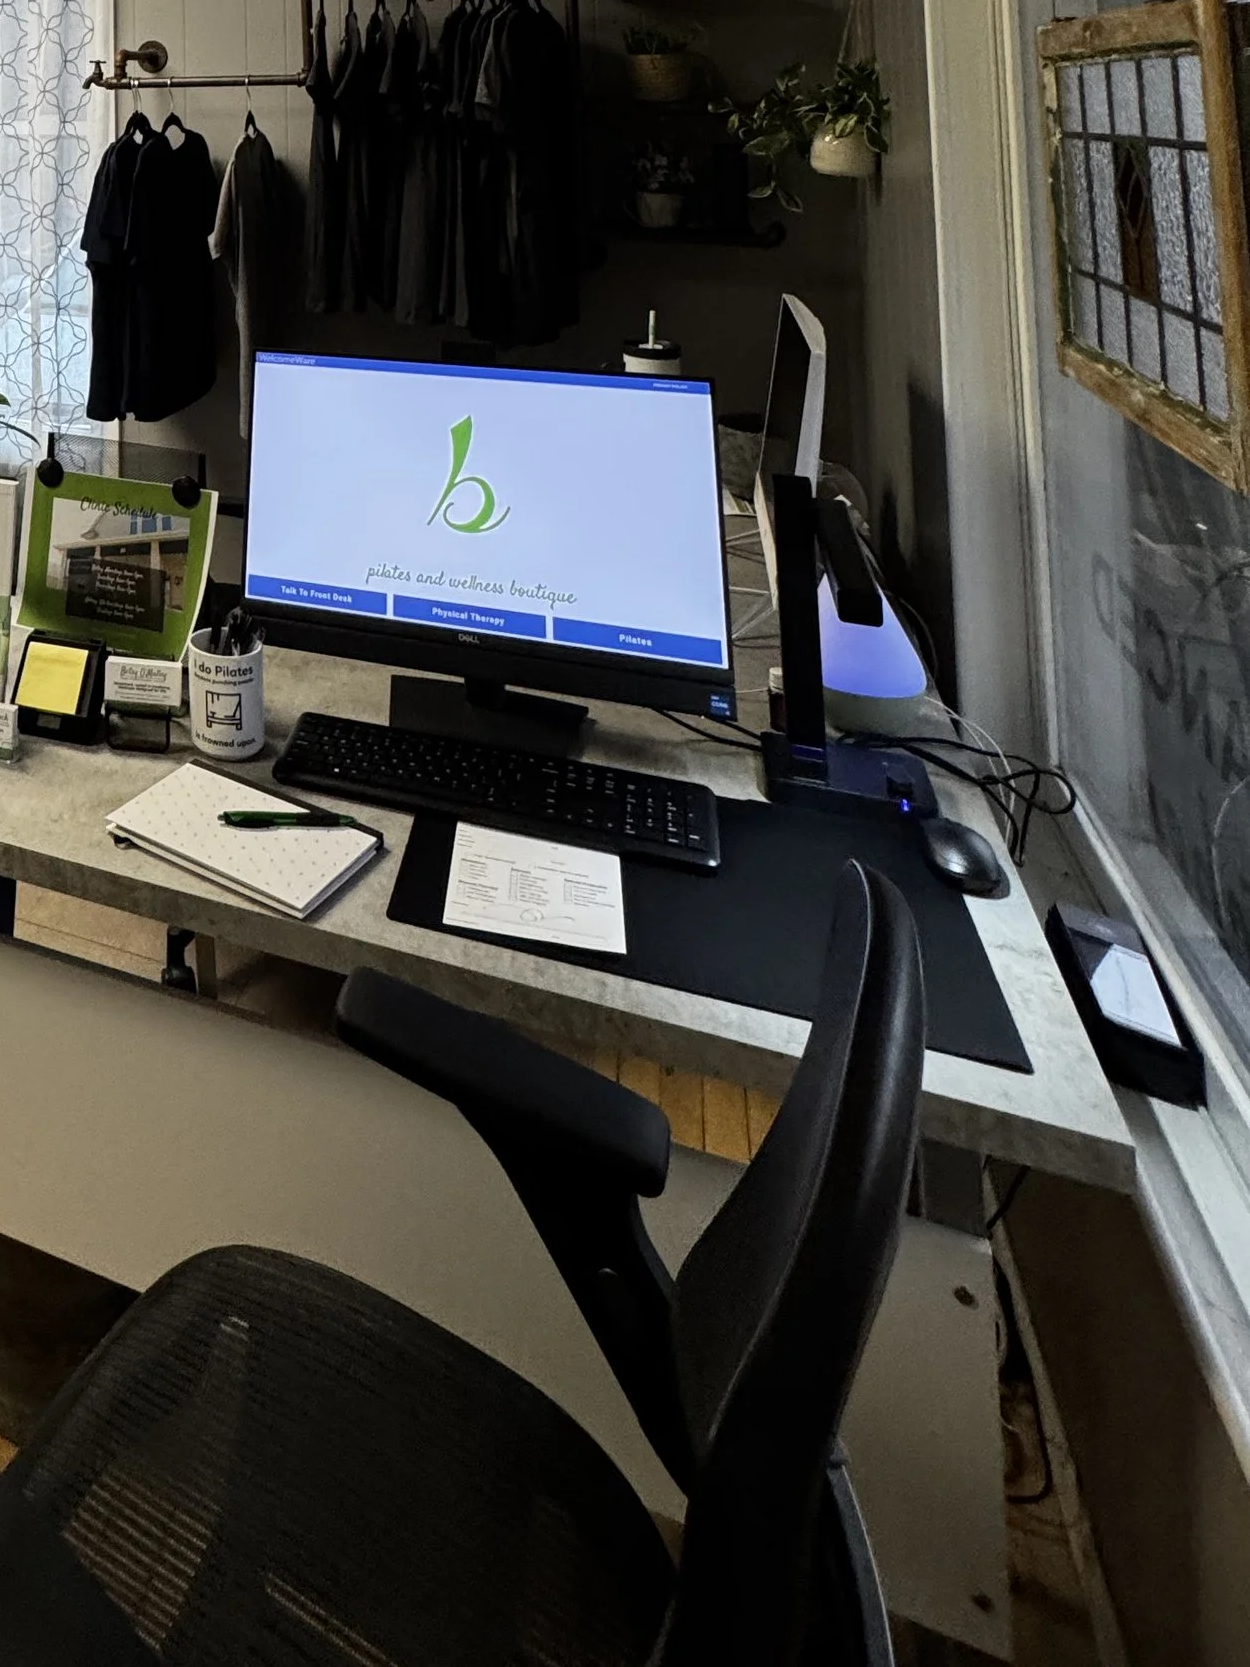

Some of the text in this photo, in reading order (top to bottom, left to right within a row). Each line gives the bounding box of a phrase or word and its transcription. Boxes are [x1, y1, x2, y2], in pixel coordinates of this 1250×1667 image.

[258, 353, 317, 365] WelcomeWare
[80, 496, 160, 519] Clinic Schedule
[281, 584, 353, 604] Talk To Front Desk
[365, 563, 578, 610] pilates and wellness boutique
[431, 606, 506, 628] Physical Therapy
[458, 633, 481, 645] DELL
[618, 633, 653, 647] Pilates
[198, 661, 212, 674] do
[215, 665, 254, 678] Pilates
[202, 733, 235, 748] frowned
[236, 737, 257, 749] upon
